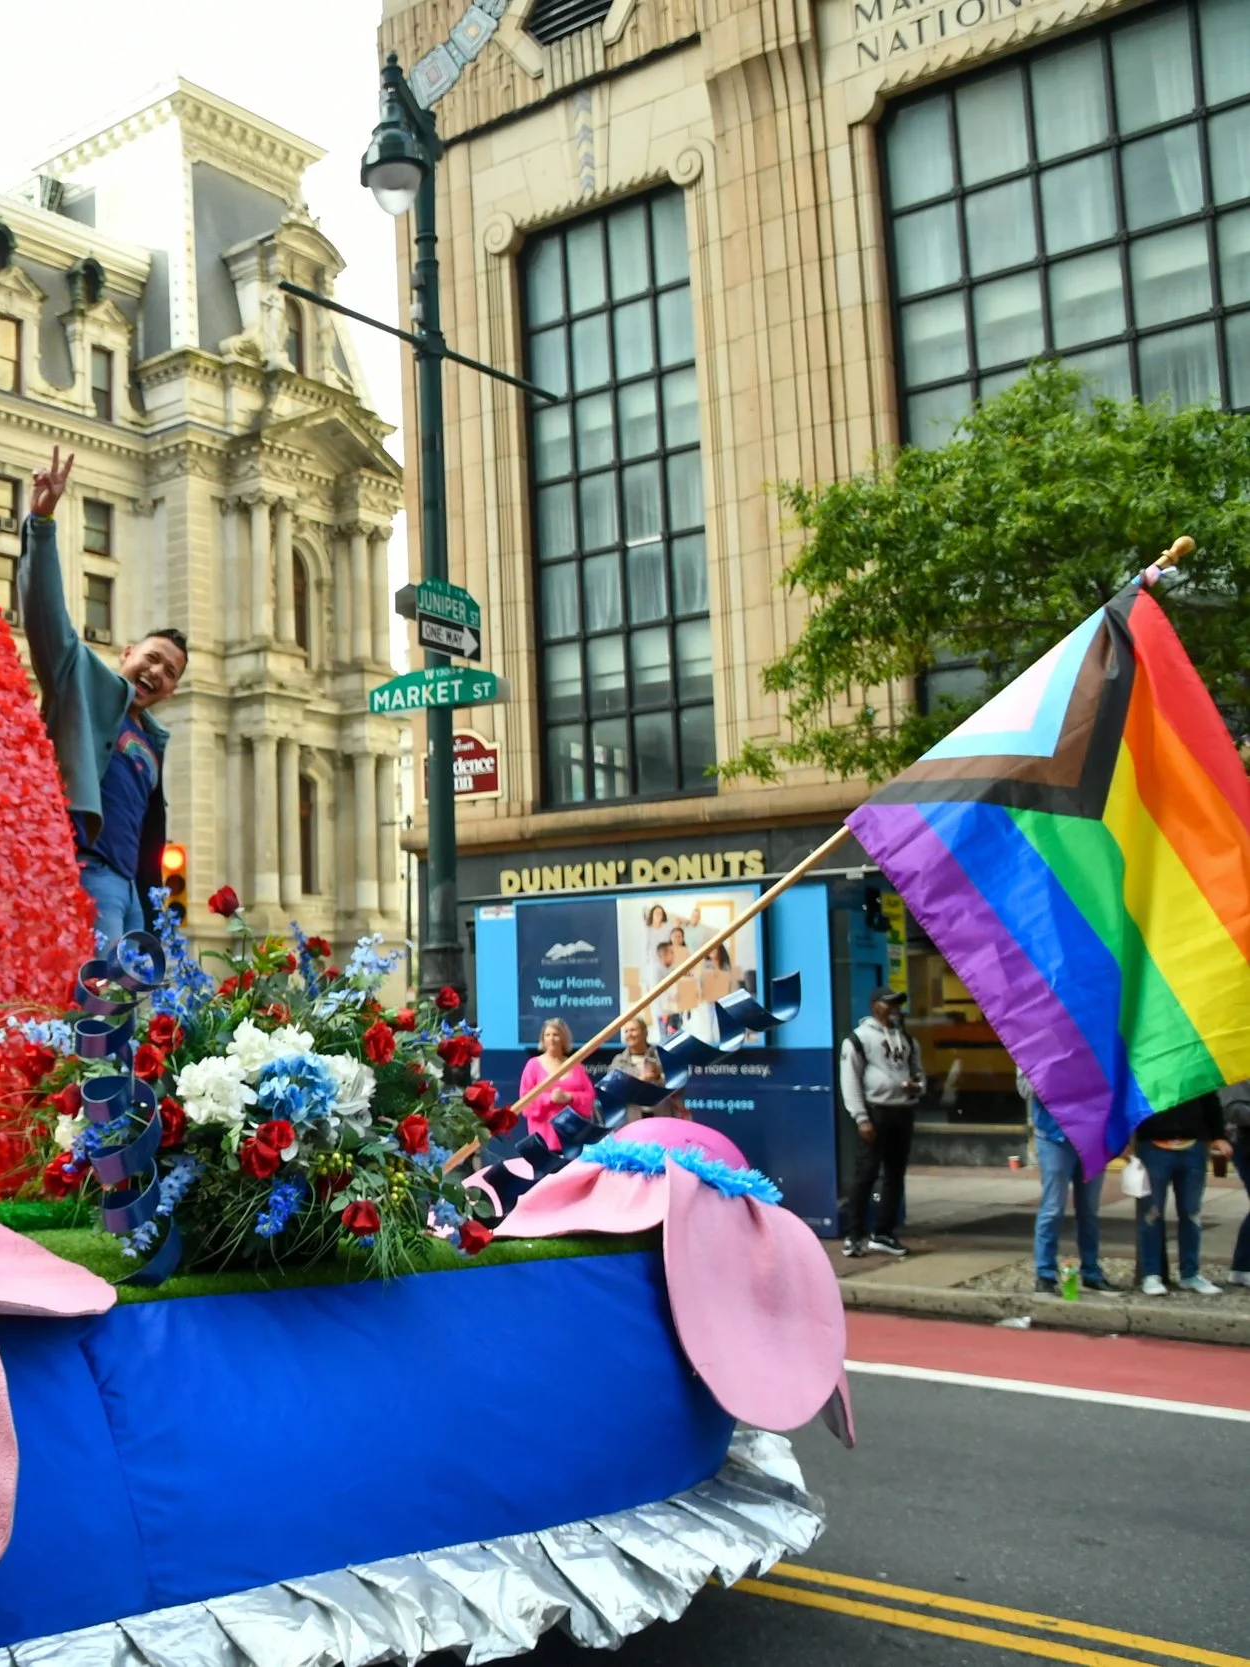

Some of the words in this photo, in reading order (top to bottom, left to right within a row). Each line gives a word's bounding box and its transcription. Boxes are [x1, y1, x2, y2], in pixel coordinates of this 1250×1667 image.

[419, 588, 467, 622] JUNIPER
[470, 611, 479, 626] ST
[424, 624, 443, 640] ONE
[445, 629, 463, 647] WAY
[373, 679, 463, 712] MARKET
[472, 681, 491, 699] ST
[453, 756, 495, 775] dence
[454, 775, 474, 792] nn
[500, 860, 626, 895] DUNKIN'
[631, 849, 764, 884] DONUTS
[537, 976, 564, 990] Your
[566, 976, 606, 990] Home,
[531, 995, 558, 1008] Your
[560, 994, 613, 1008] Freedom
